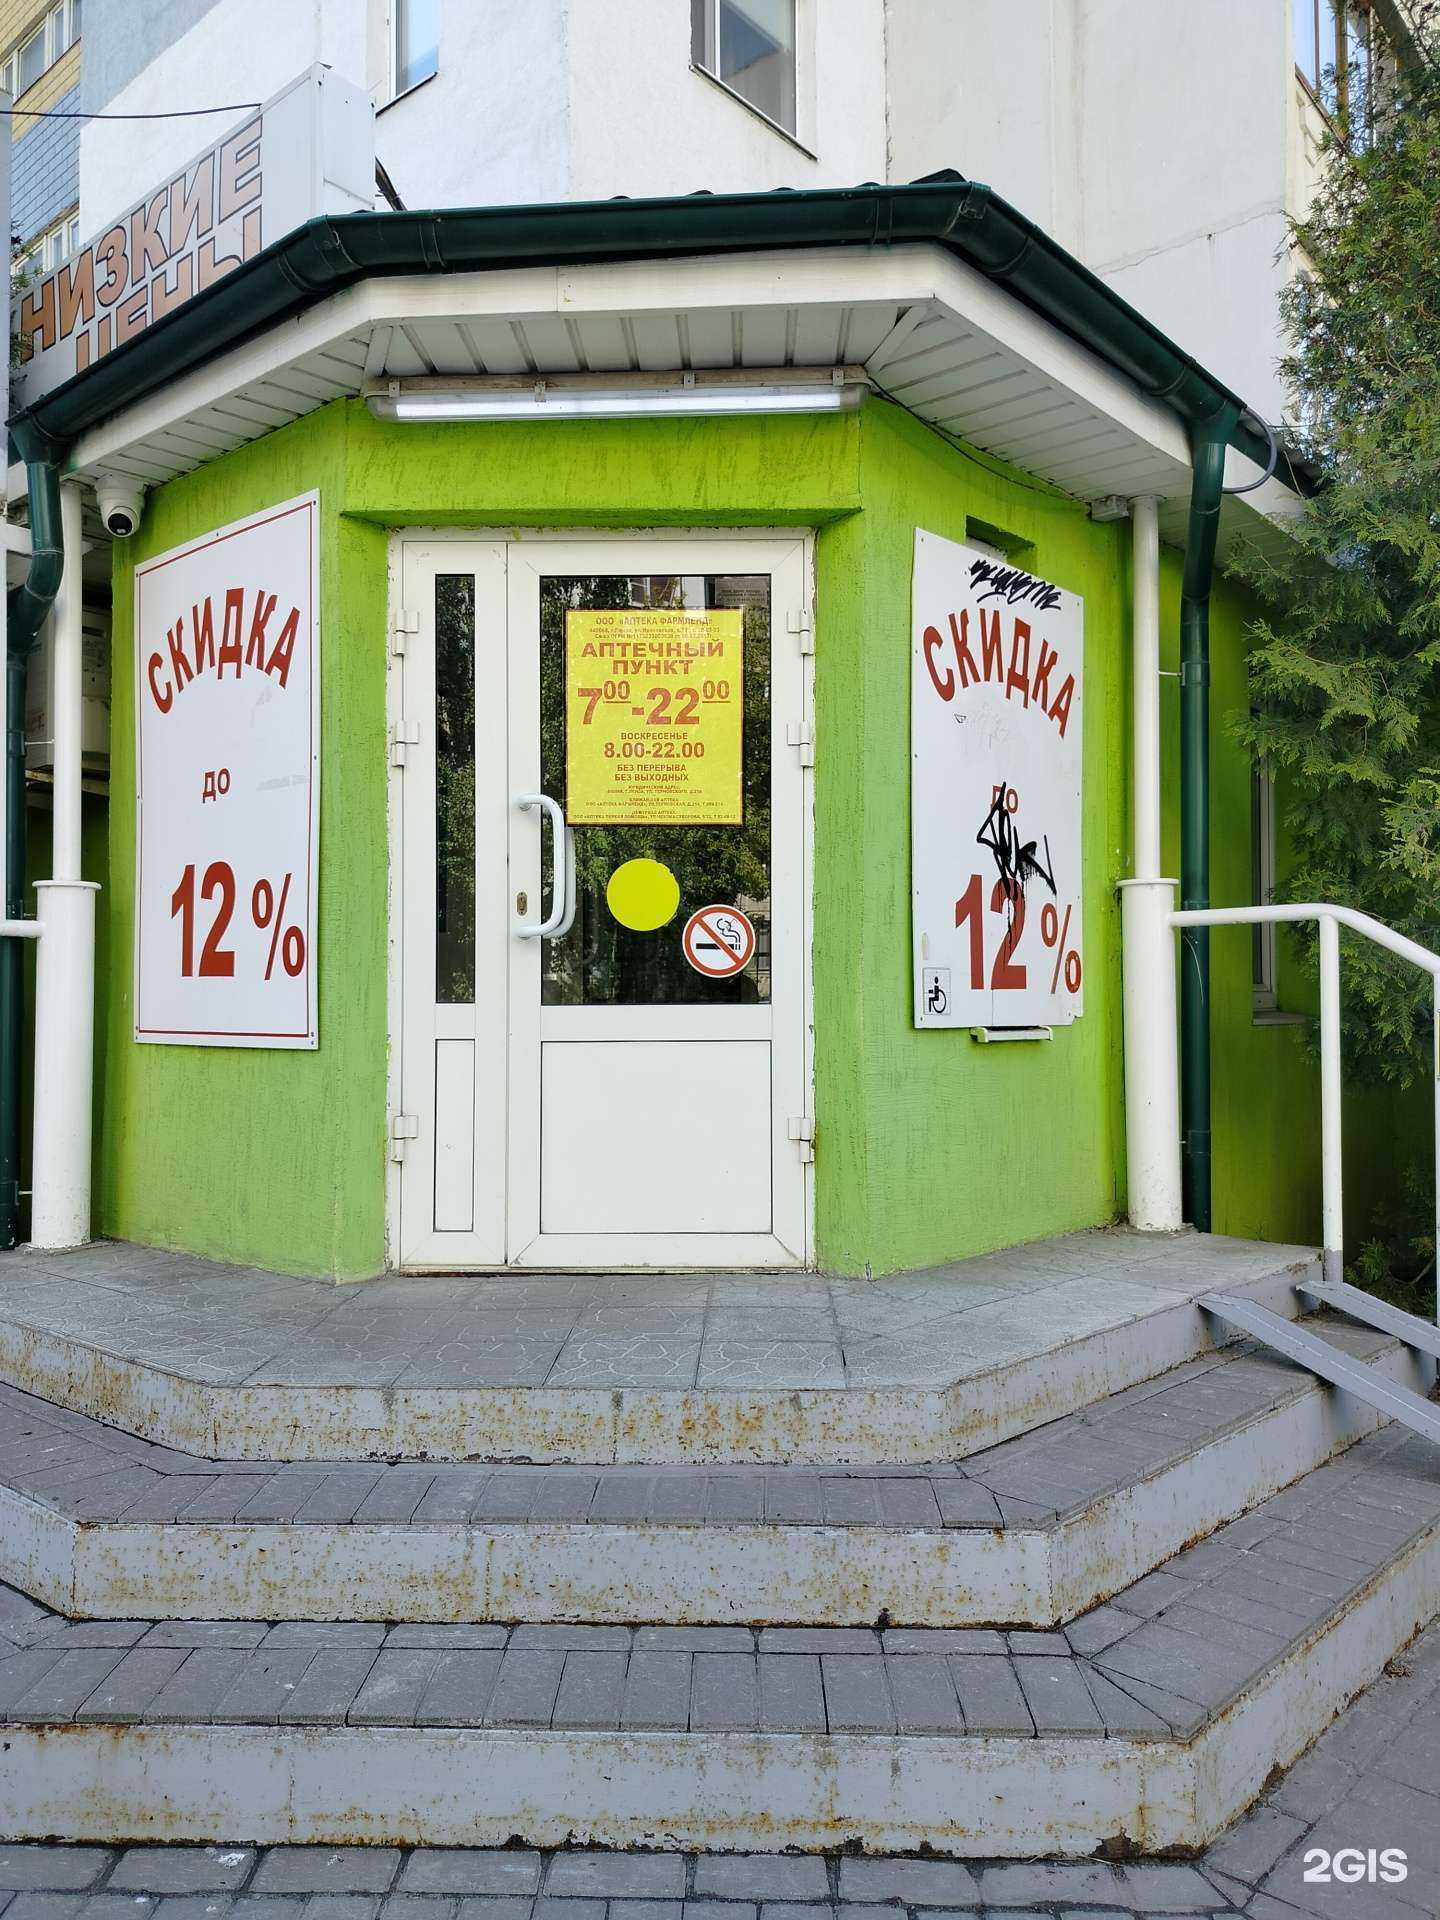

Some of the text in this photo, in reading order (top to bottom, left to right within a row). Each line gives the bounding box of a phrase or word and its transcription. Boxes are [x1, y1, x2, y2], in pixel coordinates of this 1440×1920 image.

[20, 115, 263, 365] НИЗКИЕ
[595, 617, 614, 625] ООО
[147, 588, 300, 714] СКИДКА
[581, 638, 724, 658] АПТЕЧНЫЙ
[612, 659, 694, 675] ПУНКТ
[922, 608, 1076, 739] СКИДКА
[620, 732, 689, 740] ВОСКРЕСЕНЬЕ
[603, 742, 705, 758] 8.00-22.00
[616, 764, 686, 772] БЕЗ ПЕРЕРЫВА
[614, 773, 689, 782] БЕЗ ВЫХОДНЫХ
